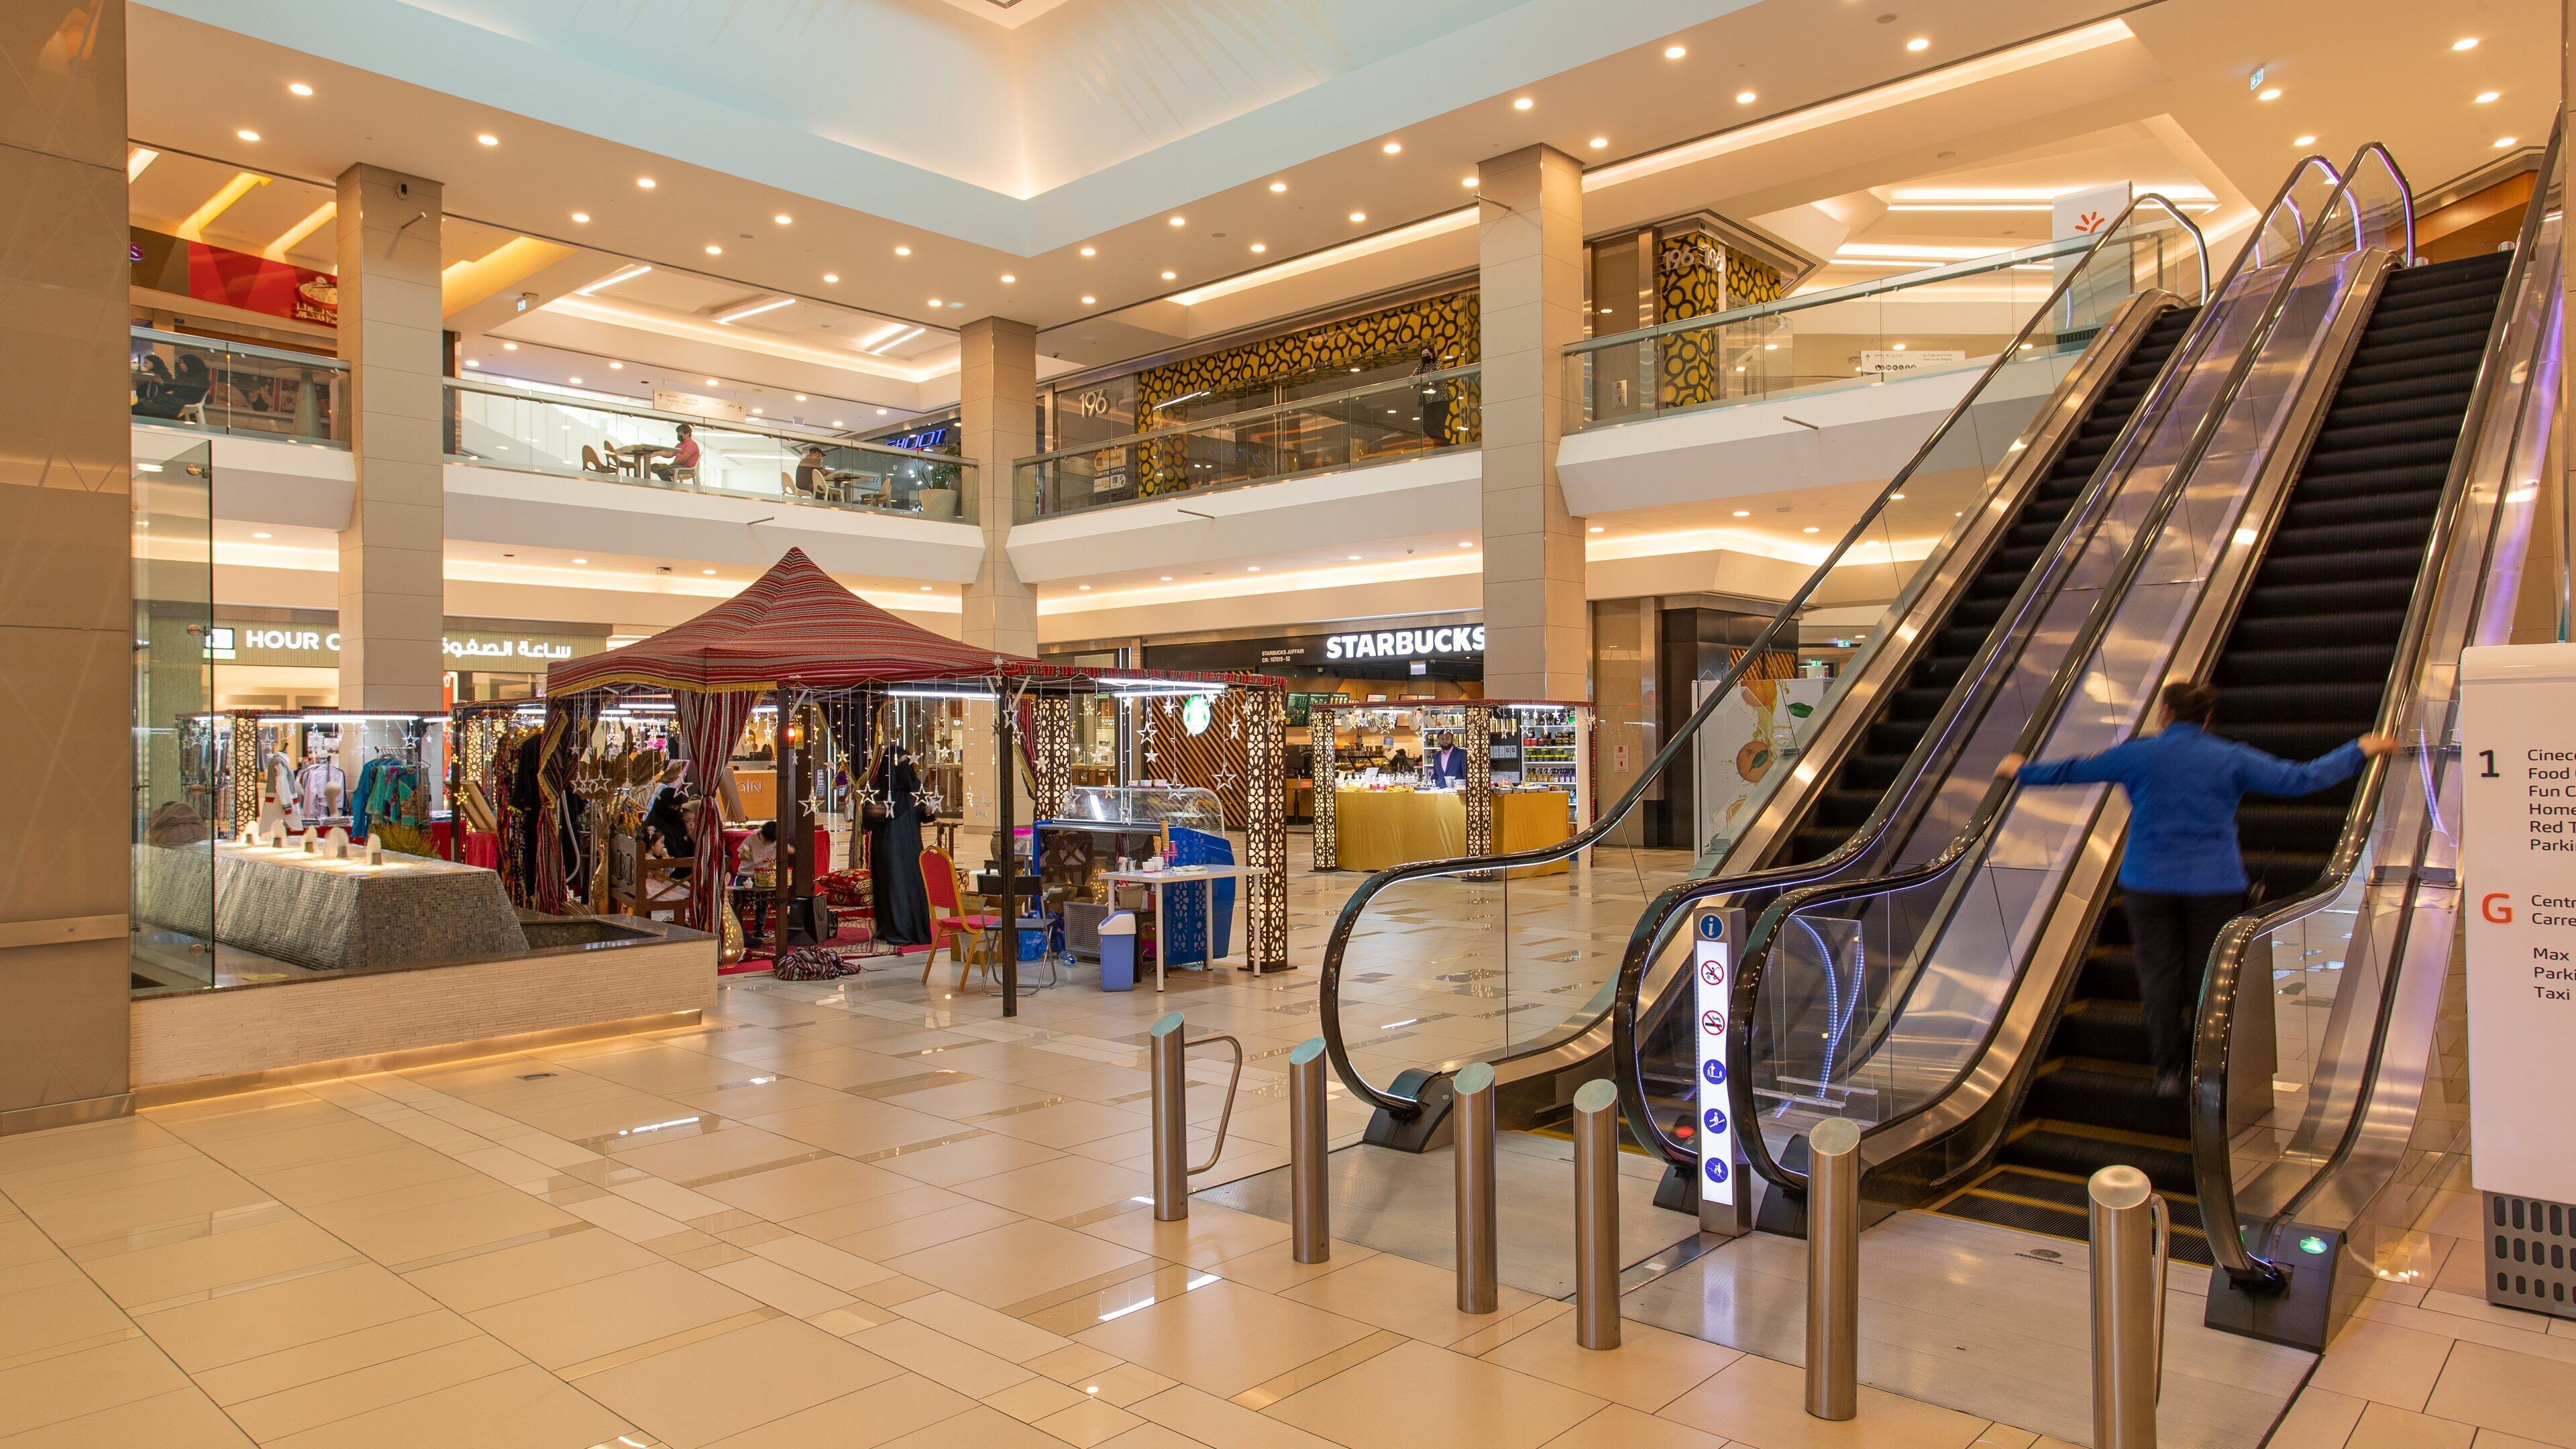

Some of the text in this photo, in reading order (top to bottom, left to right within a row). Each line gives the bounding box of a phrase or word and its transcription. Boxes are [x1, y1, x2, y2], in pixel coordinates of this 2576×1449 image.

[1664, 247, 1695, 271] 196
[1079, 388, 1108, 418] 196
[246, 630, 319, 650] HOUR
[1326, 626, 1485, 659] STARBUCKS
[517, 640, 572, 658] ساعة
[2527, 749, 2576, 761] Cinec
[2479, 749, 2500, 777] 1
[2528, 767, 2570, 780] Food
[2529, 786, 2560, 797] Fun
[2530, 820, 2563, 833] Red
[2530, 839, 2576, 852] Parki
[2481, 892, 2512, 924] G
[2532, 912, 2576, 926] Carre
[2533, 947, 2570, 961] Max
[2533, 986, 2571, 1000] Taxi
